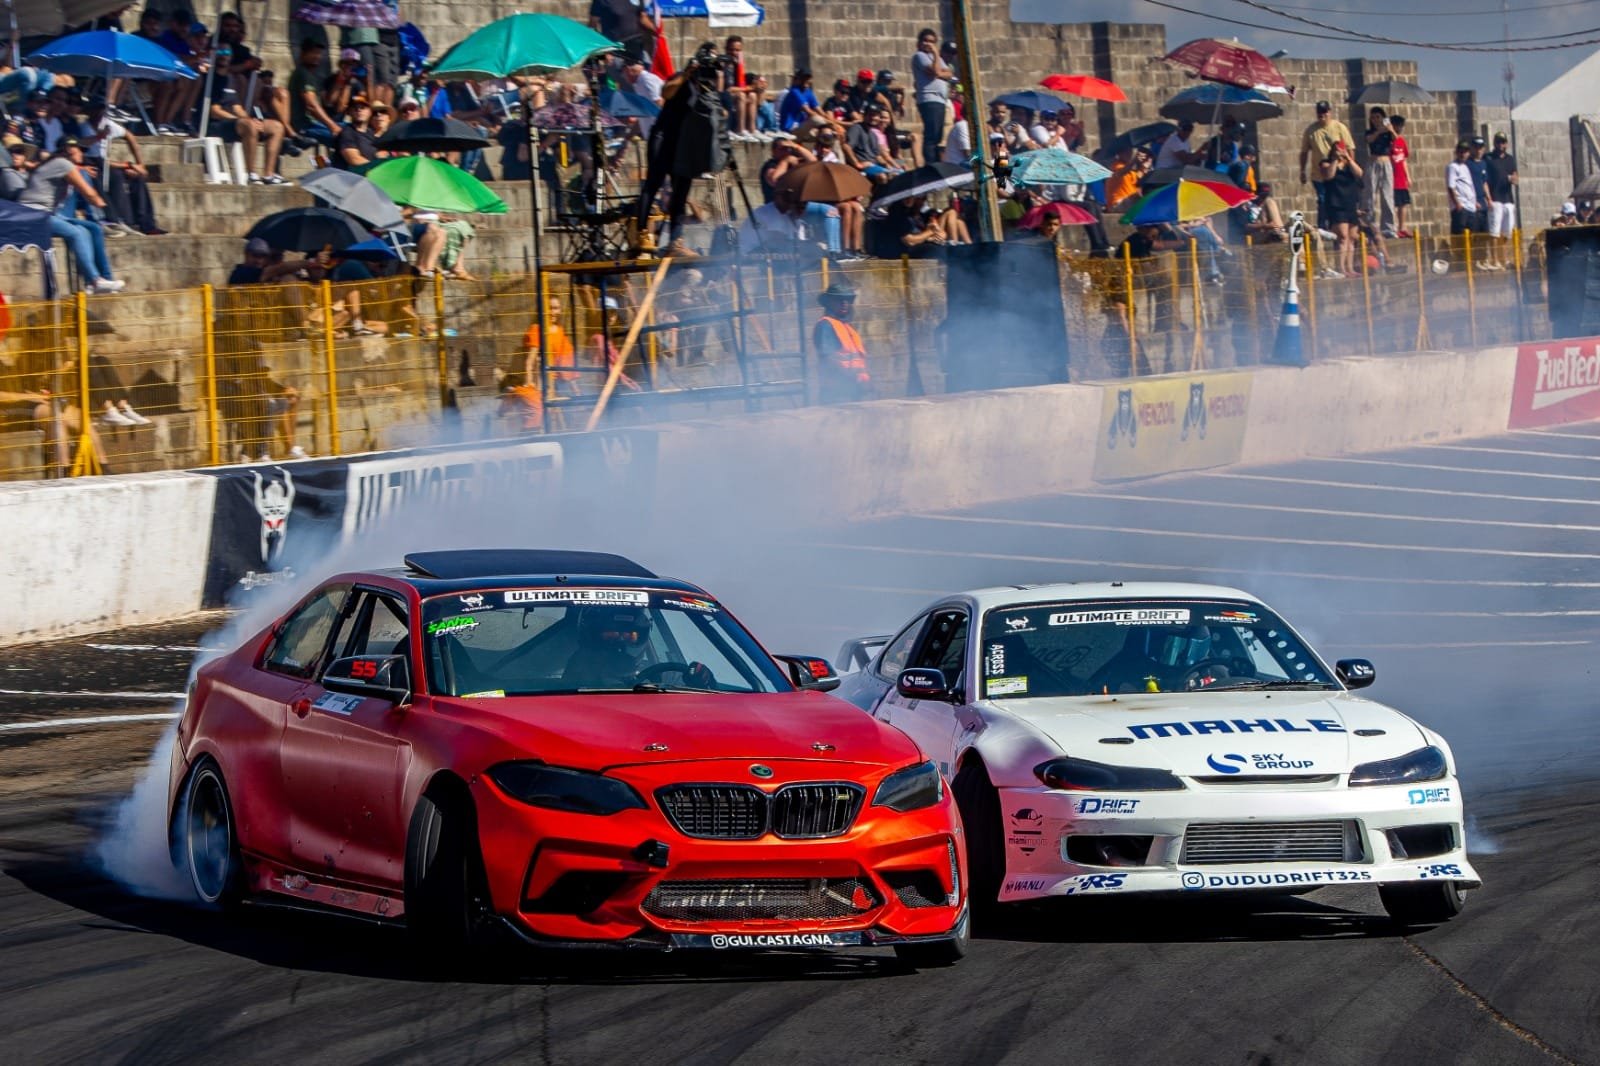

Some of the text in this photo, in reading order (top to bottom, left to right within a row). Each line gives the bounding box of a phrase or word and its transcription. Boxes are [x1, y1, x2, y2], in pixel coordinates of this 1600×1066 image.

[511, 591, 642, 601] ULTIMATE DRIFT
[427, 616, 475, 634] SANTA
[1056, 610, 1184, 624] ULTIMATE DRIFT
[990, 644, 1004, 675] ACROSS
[350, 660, 377, 678] 55
[1127, 719, 1347, 740] MAHLE
[1252, 754, 1285, 762] SKY
[1254, 761, 1315, 770] GROUP
[1407, 787, 1450, 805] DRIFT
[1079, 798, 1141, 814] DRIFT
[1014, 881, 1045, 891] WANLI
[1081, 873, 1128, 891] RS
[1208, 871, 1372, 887] DUDUDRIFT325
[728, 935, 833, 946] GUI.CASTAGNA
